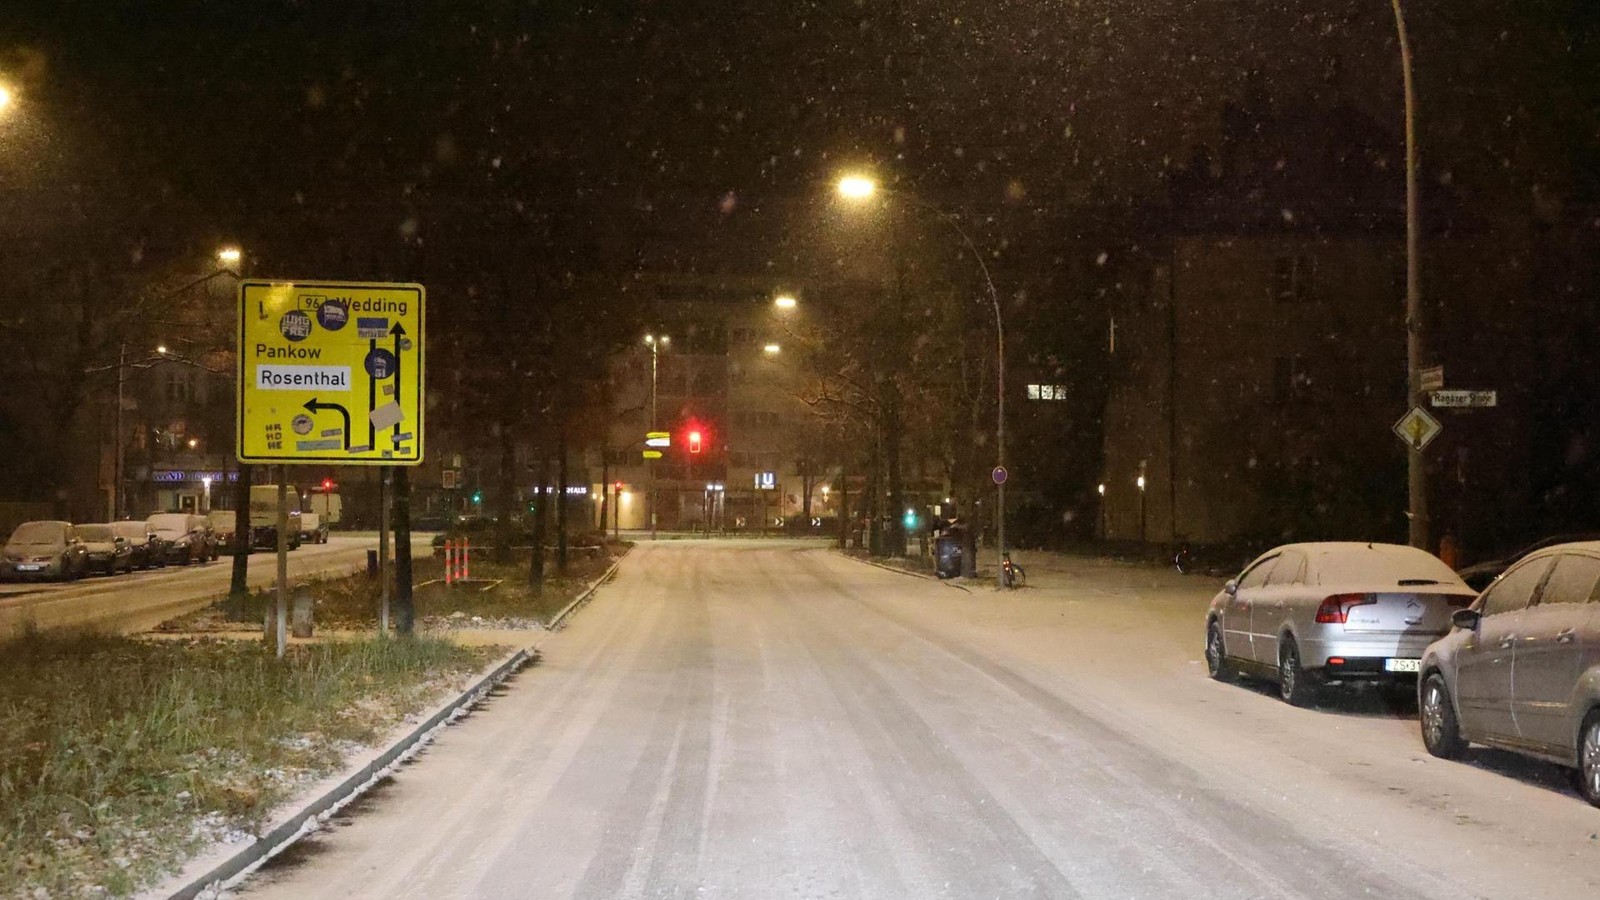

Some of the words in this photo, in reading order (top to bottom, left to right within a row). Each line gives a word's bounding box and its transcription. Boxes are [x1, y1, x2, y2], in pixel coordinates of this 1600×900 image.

[305, 297, 320, 309] 96
[336, 297, 408, 316] Wedding
[256, 343, 322, 359] Pankow
[261, 370, 346, 386] Rosenthal
[763, 472, 773, 485] U
